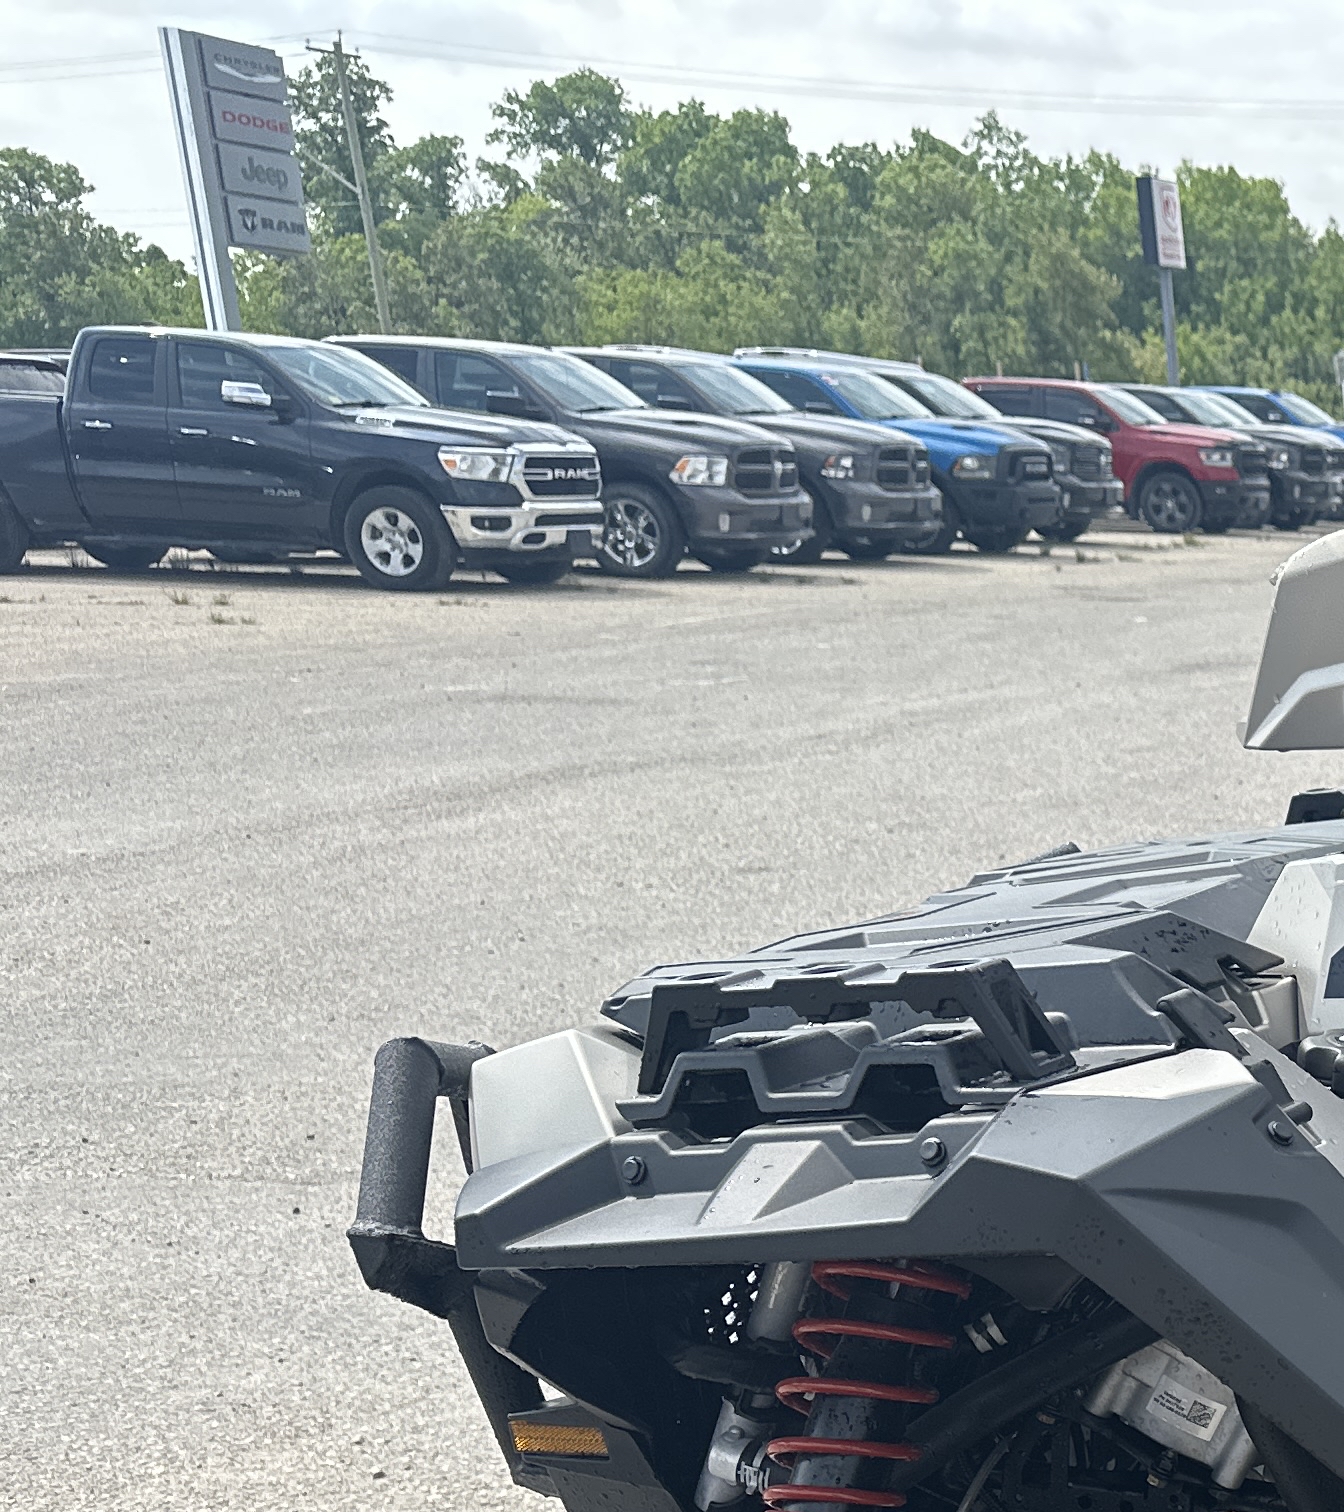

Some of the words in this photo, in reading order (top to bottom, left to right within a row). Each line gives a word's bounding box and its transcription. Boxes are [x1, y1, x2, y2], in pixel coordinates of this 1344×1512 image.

[214, 53, 281, 74] CHRYSLER
[221, 110, 290, 134] DODGE
[241, 156, 288, 191] Jeep
[261, 215, 305, 235] RAM
